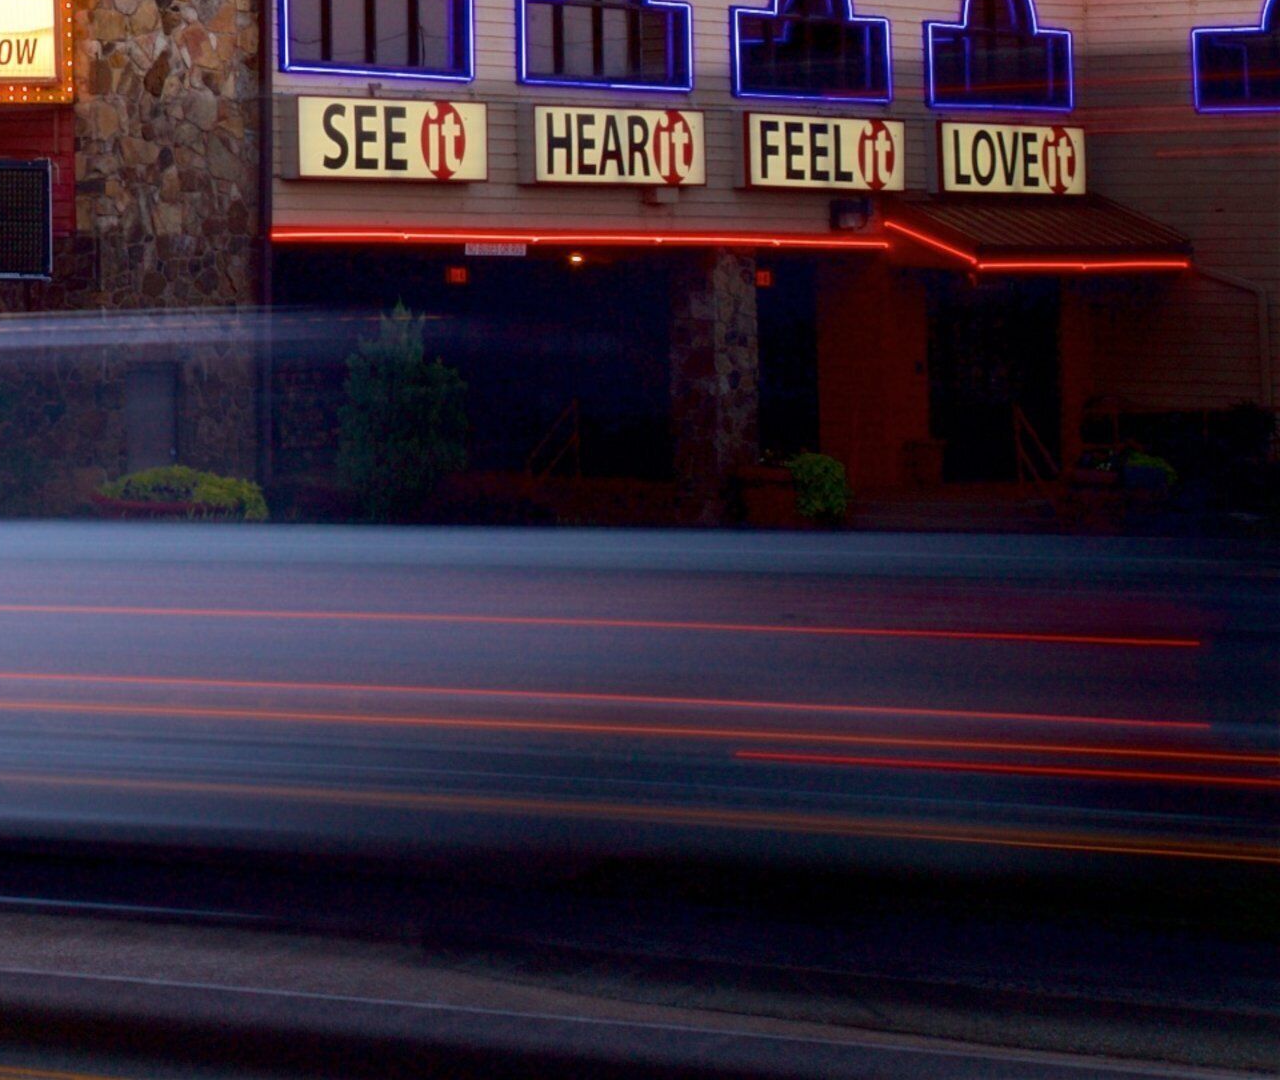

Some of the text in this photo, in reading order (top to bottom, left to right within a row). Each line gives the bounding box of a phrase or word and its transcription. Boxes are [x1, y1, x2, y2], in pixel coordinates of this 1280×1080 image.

[322, 101, 462, 173] SEE it
[546, 110, 691, 183] HEAR it
[759, 120, 892, 185] FEEL it
[953, 128, 1074, 190] LOVE it
